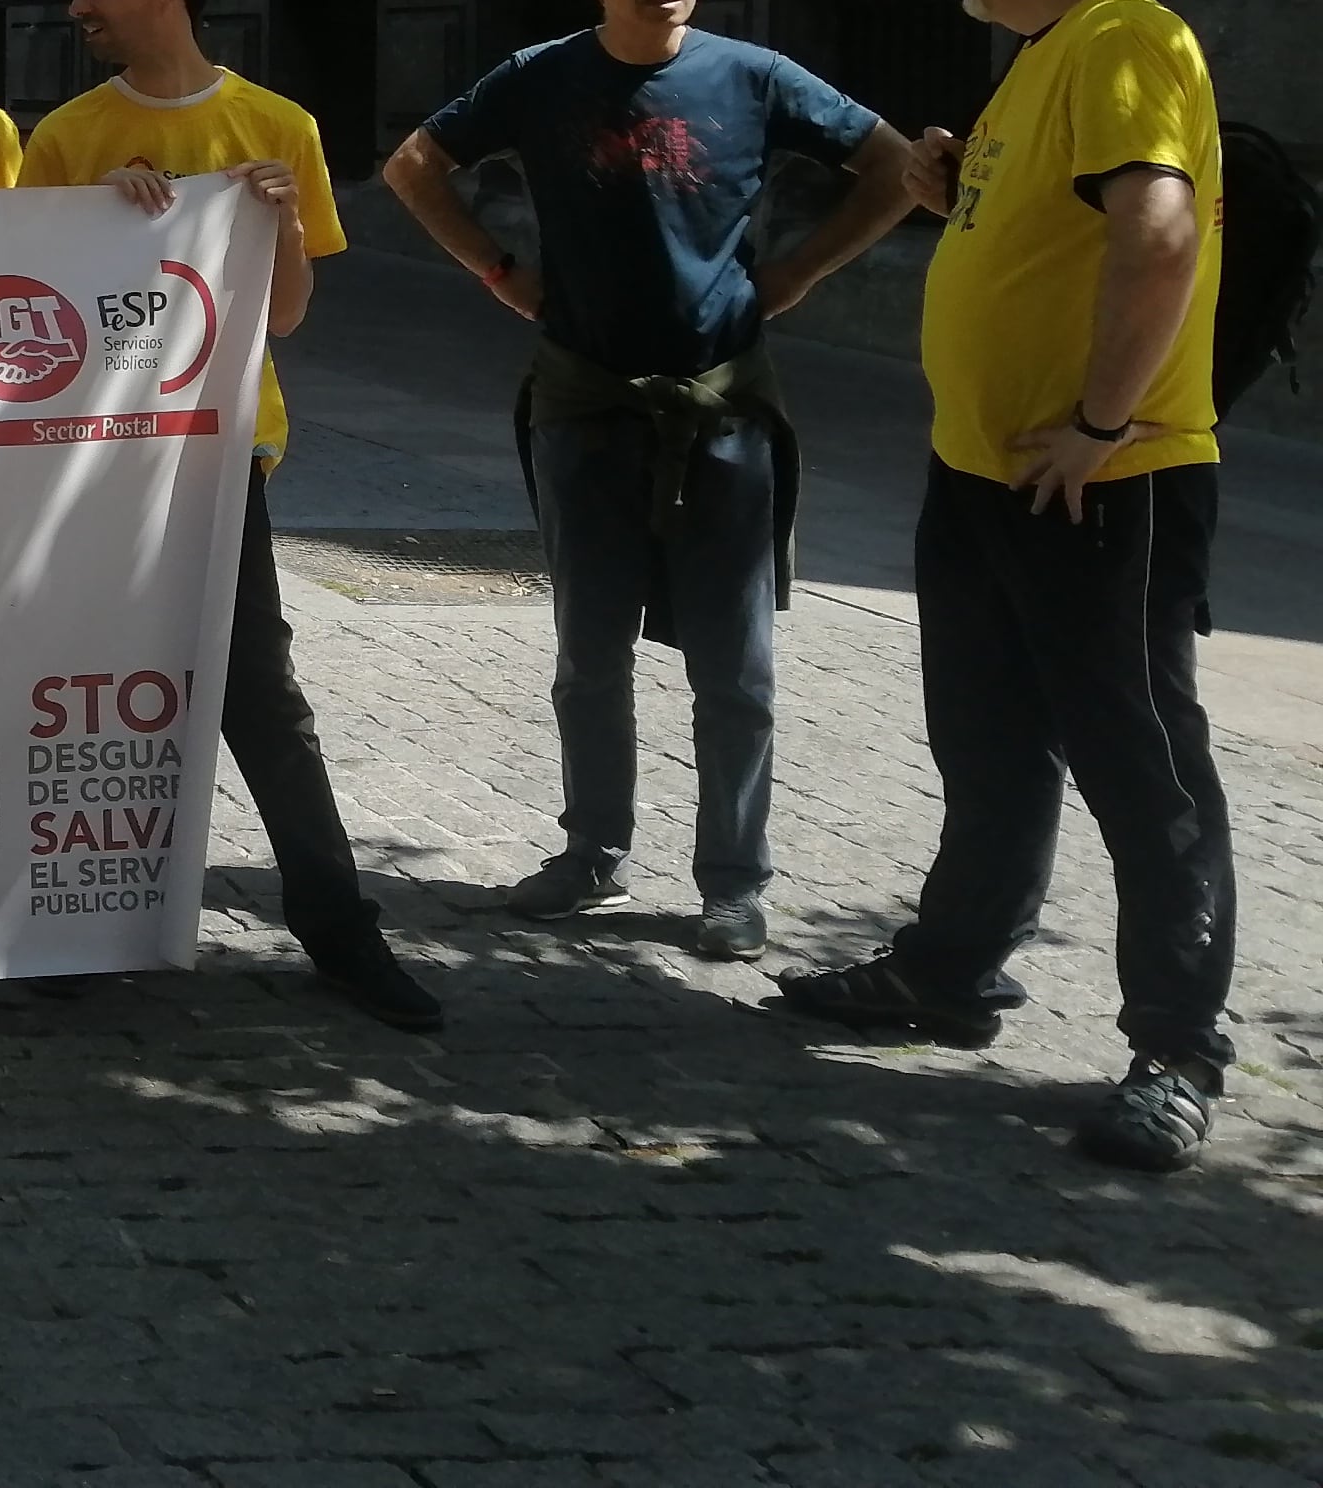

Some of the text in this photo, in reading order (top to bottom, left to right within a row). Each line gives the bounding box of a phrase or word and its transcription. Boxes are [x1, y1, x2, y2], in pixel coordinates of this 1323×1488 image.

[103, 335, 164, 351] Servicios
[104, 355, 159, 371] Públicos
[32, 414, 158, 442] Sector Postal
[28, 669, 194, 739] STO
[28, 738, 182, 775] DESGUA
[28, 779, 70, 806] DE
[30, 856, 170, 889] EL SERV
[144, 889, 165, 910] P
